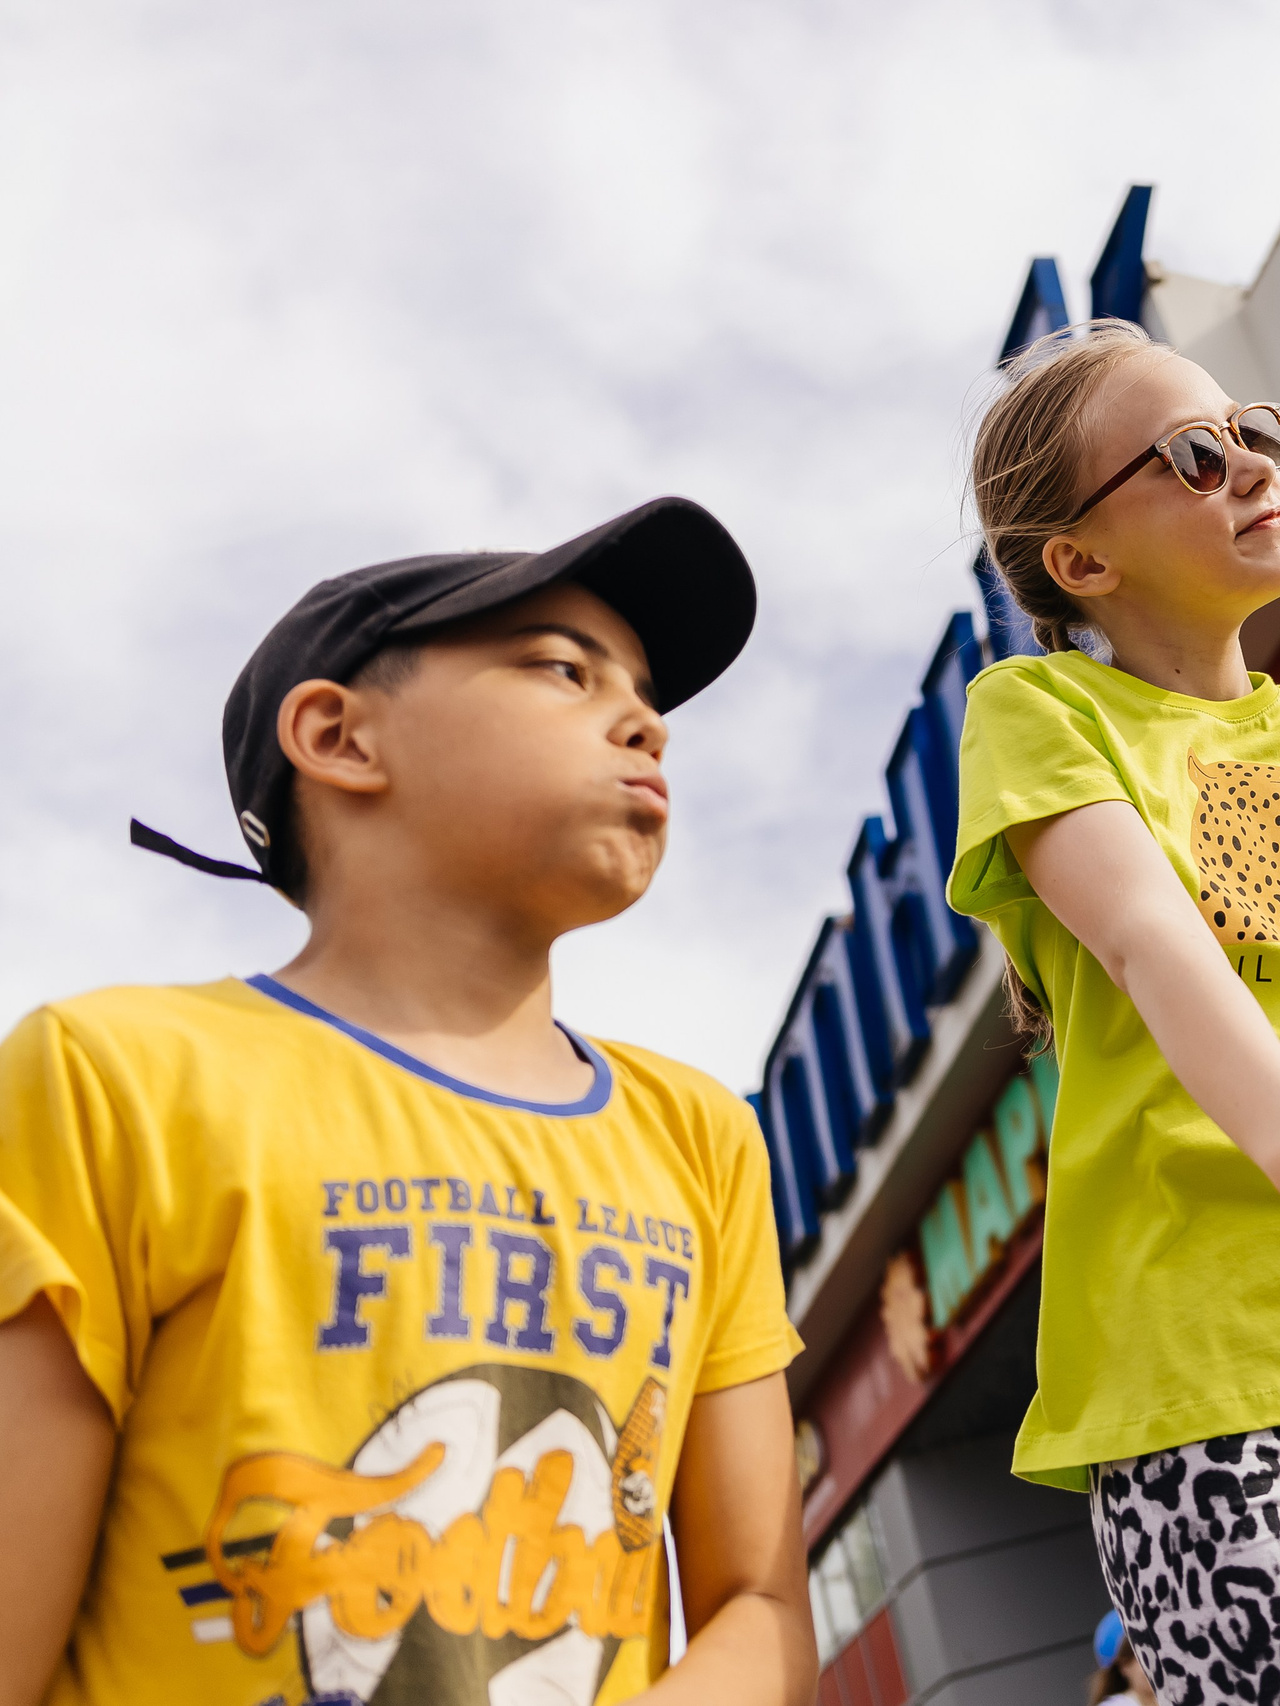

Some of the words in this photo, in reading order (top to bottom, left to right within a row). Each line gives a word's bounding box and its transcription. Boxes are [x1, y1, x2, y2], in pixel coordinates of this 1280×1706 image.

[322, 1178, 556, 1226] FOOTBALL
[577, 1197, 695, 1261] LEAGUE
[315, 1221, 691, 1372] FIRST
